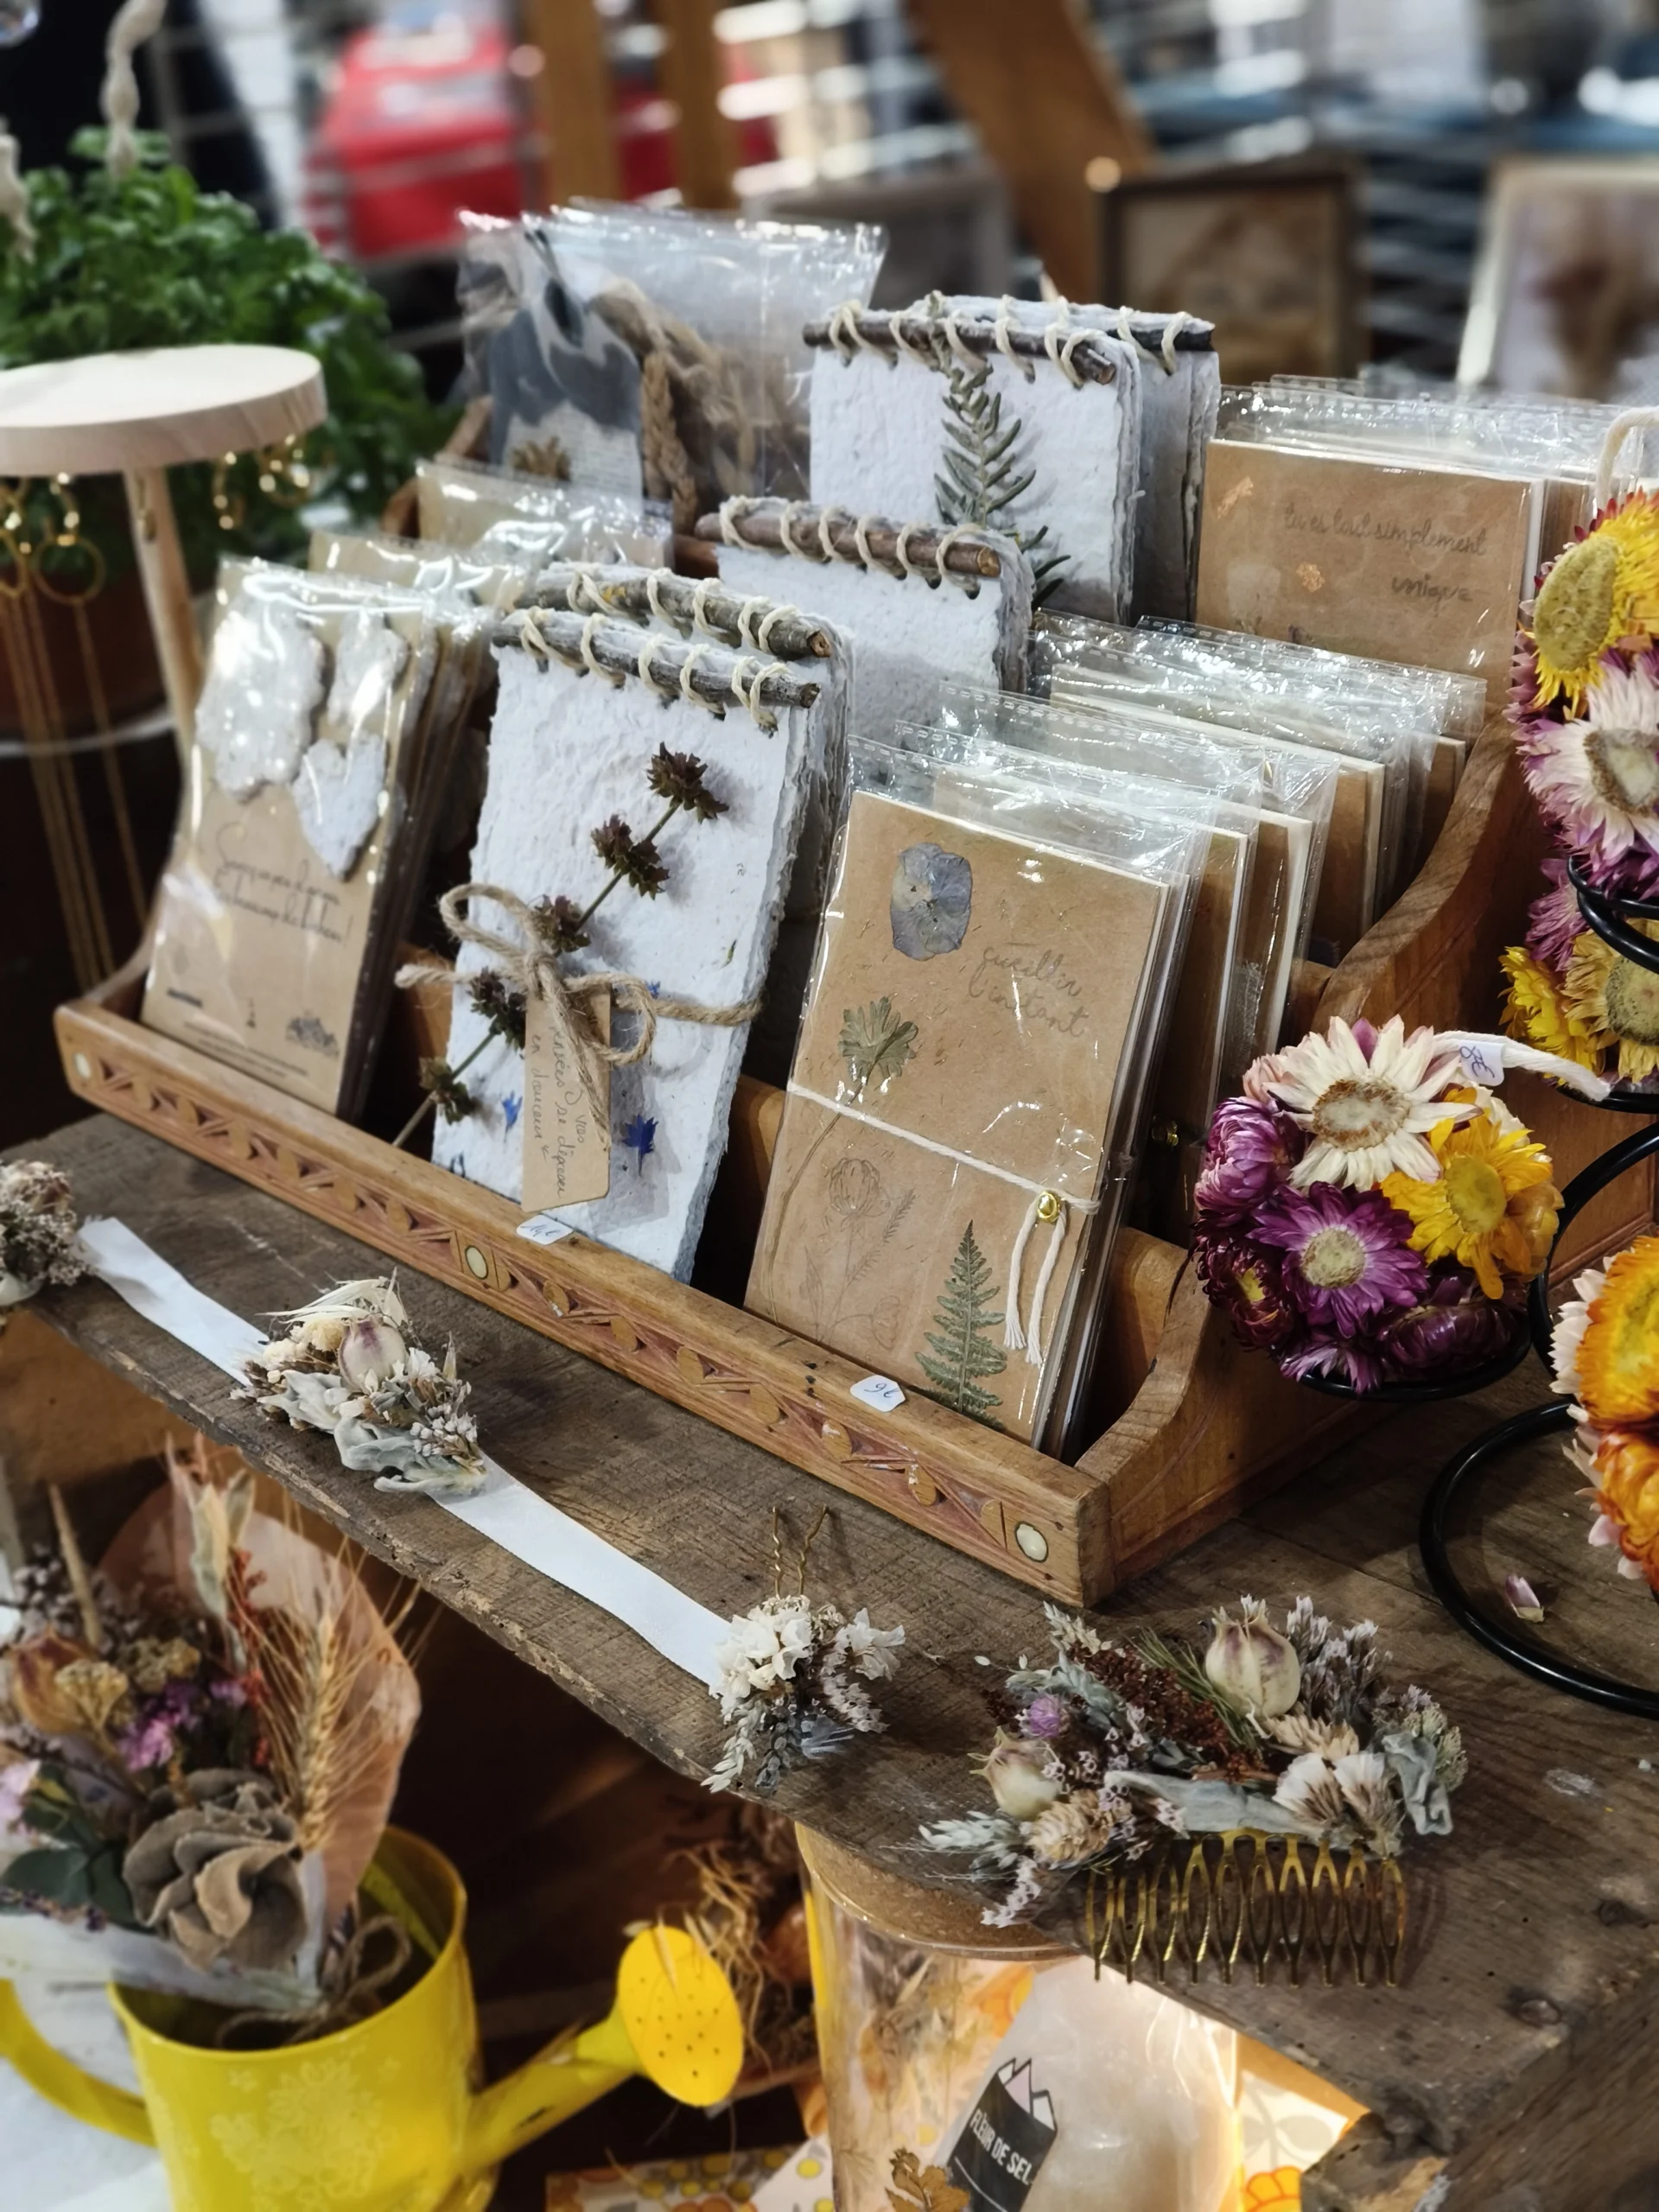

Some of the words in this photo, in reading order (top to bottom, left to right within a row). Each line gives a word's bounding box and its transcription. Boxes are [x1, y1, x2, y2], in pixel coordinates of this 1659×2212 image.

[1374, 517, 1488, 556] simplement
[1391, 573, 1474, 617] unique
[969, 2108, 996, 2152] FLEUR
[991, 2136, 1011, 2166] DE
[1006, 2152, 1033, 2186] SEL
